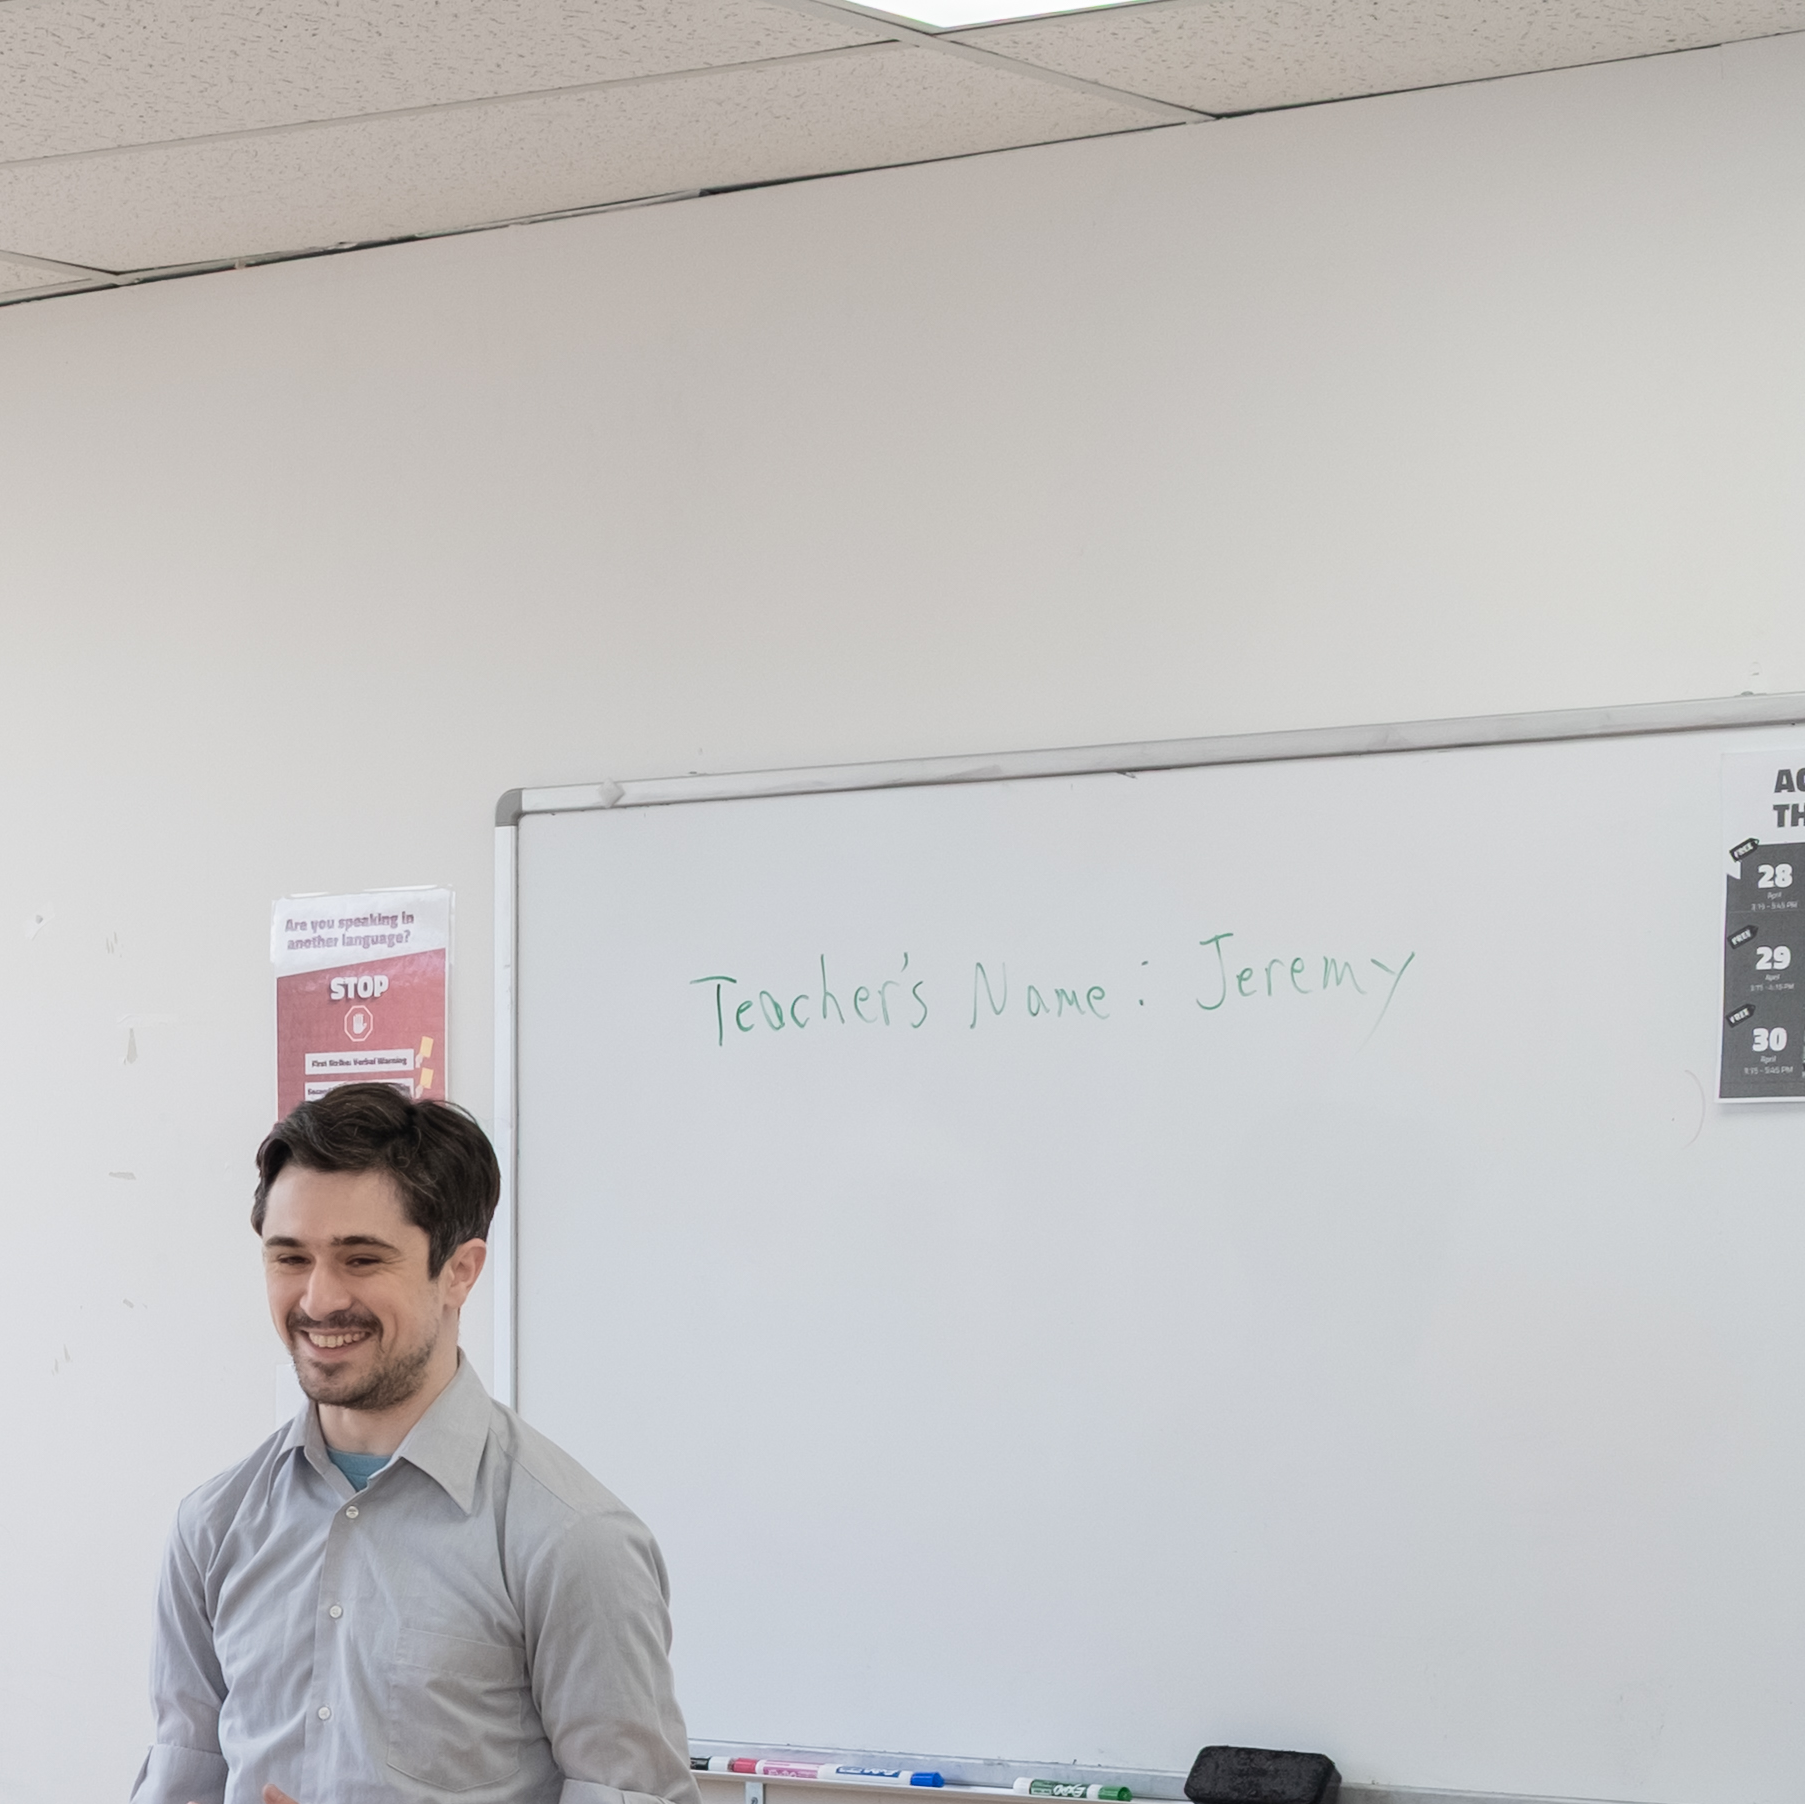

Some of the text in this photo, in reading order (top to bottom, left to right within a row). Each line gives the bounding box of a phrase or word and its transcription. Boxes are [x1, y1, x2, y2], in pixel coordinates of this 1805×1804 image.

[1757, 863, 1793, 889] 28
[285, 911, 415, 933] Are you speaking in
[287, 930, 411, 950] another language?
[1755, 946, 1791, 970] 29
[329, 975, 389, 1000] STOP
[691, 952, 928, 1046] Teacher's
[1197, 933, 1416, 1057] Jeremy
[1752, 1027, 1788, 1052] 30
